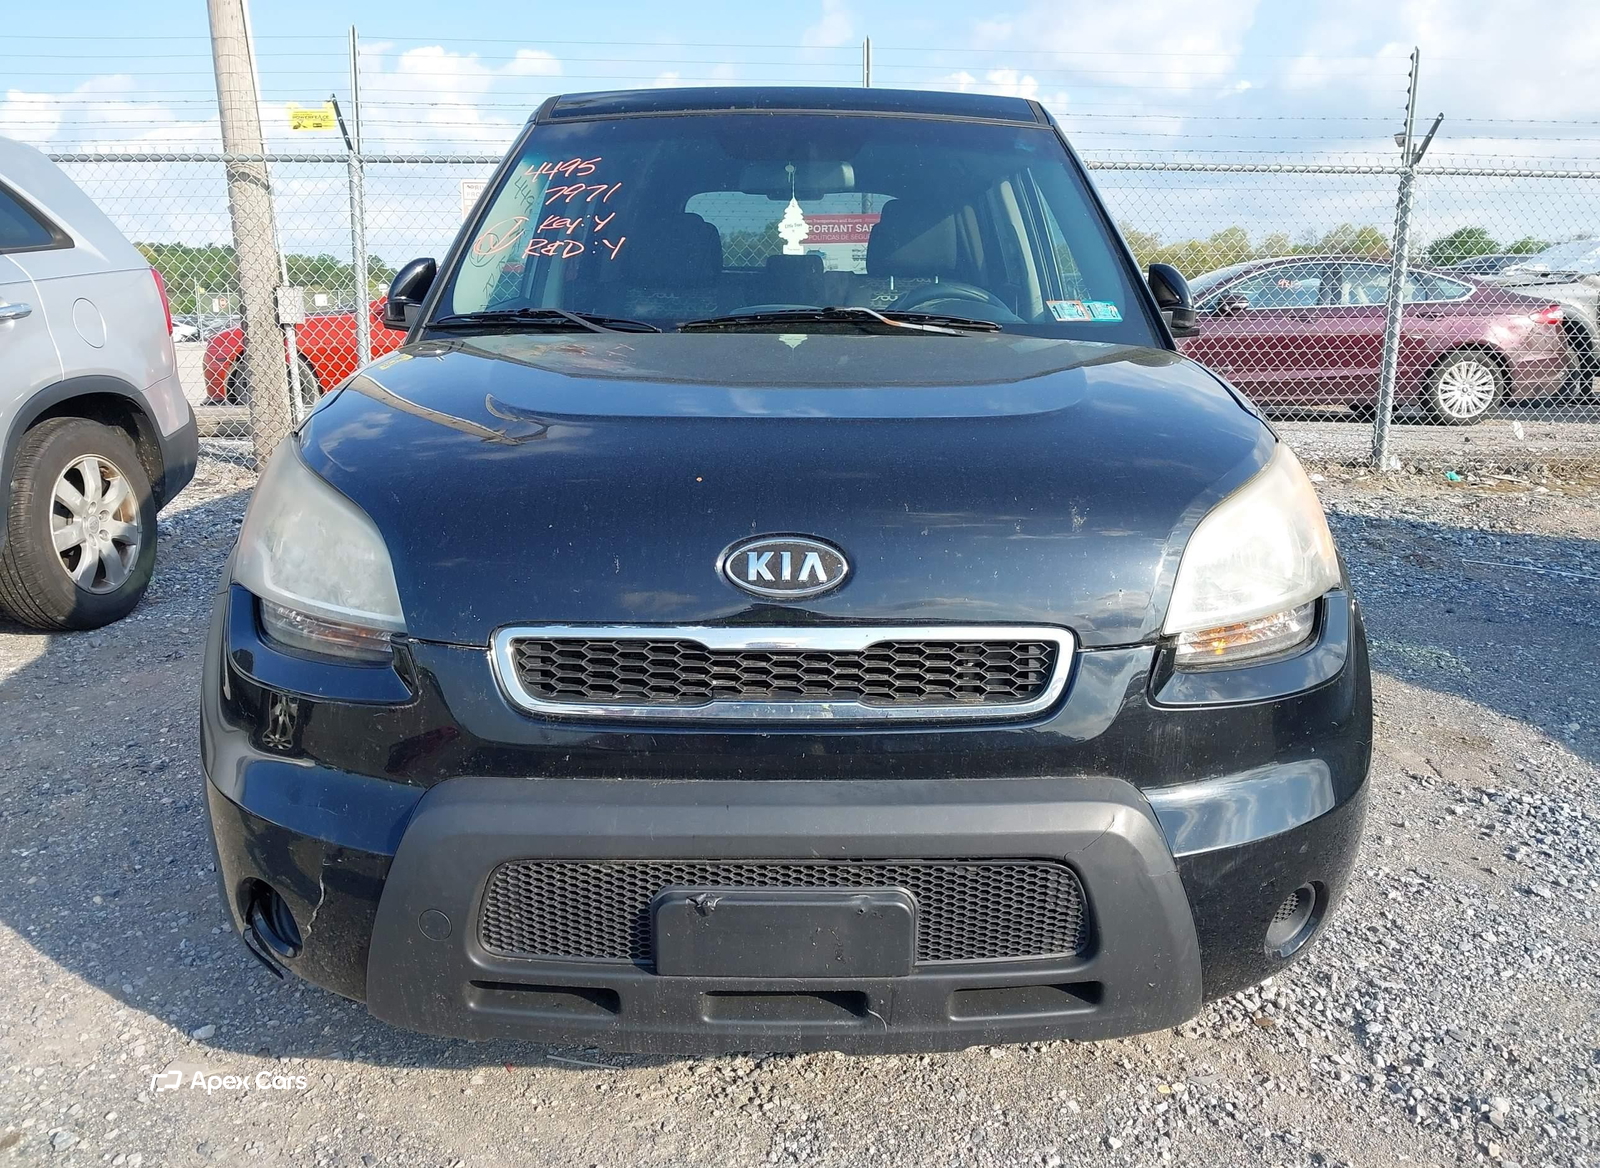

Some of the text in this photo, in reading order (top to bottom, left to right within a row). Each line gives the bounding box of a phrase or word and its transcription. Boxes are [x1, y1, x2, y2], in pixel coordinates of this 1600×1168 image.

[524, 157, 602, 183] 4495
[545, 182, 622, 206] 7971
[808, 223, 875, 233] PORTANT SAF
[746, 551, 828, 583] KIA
